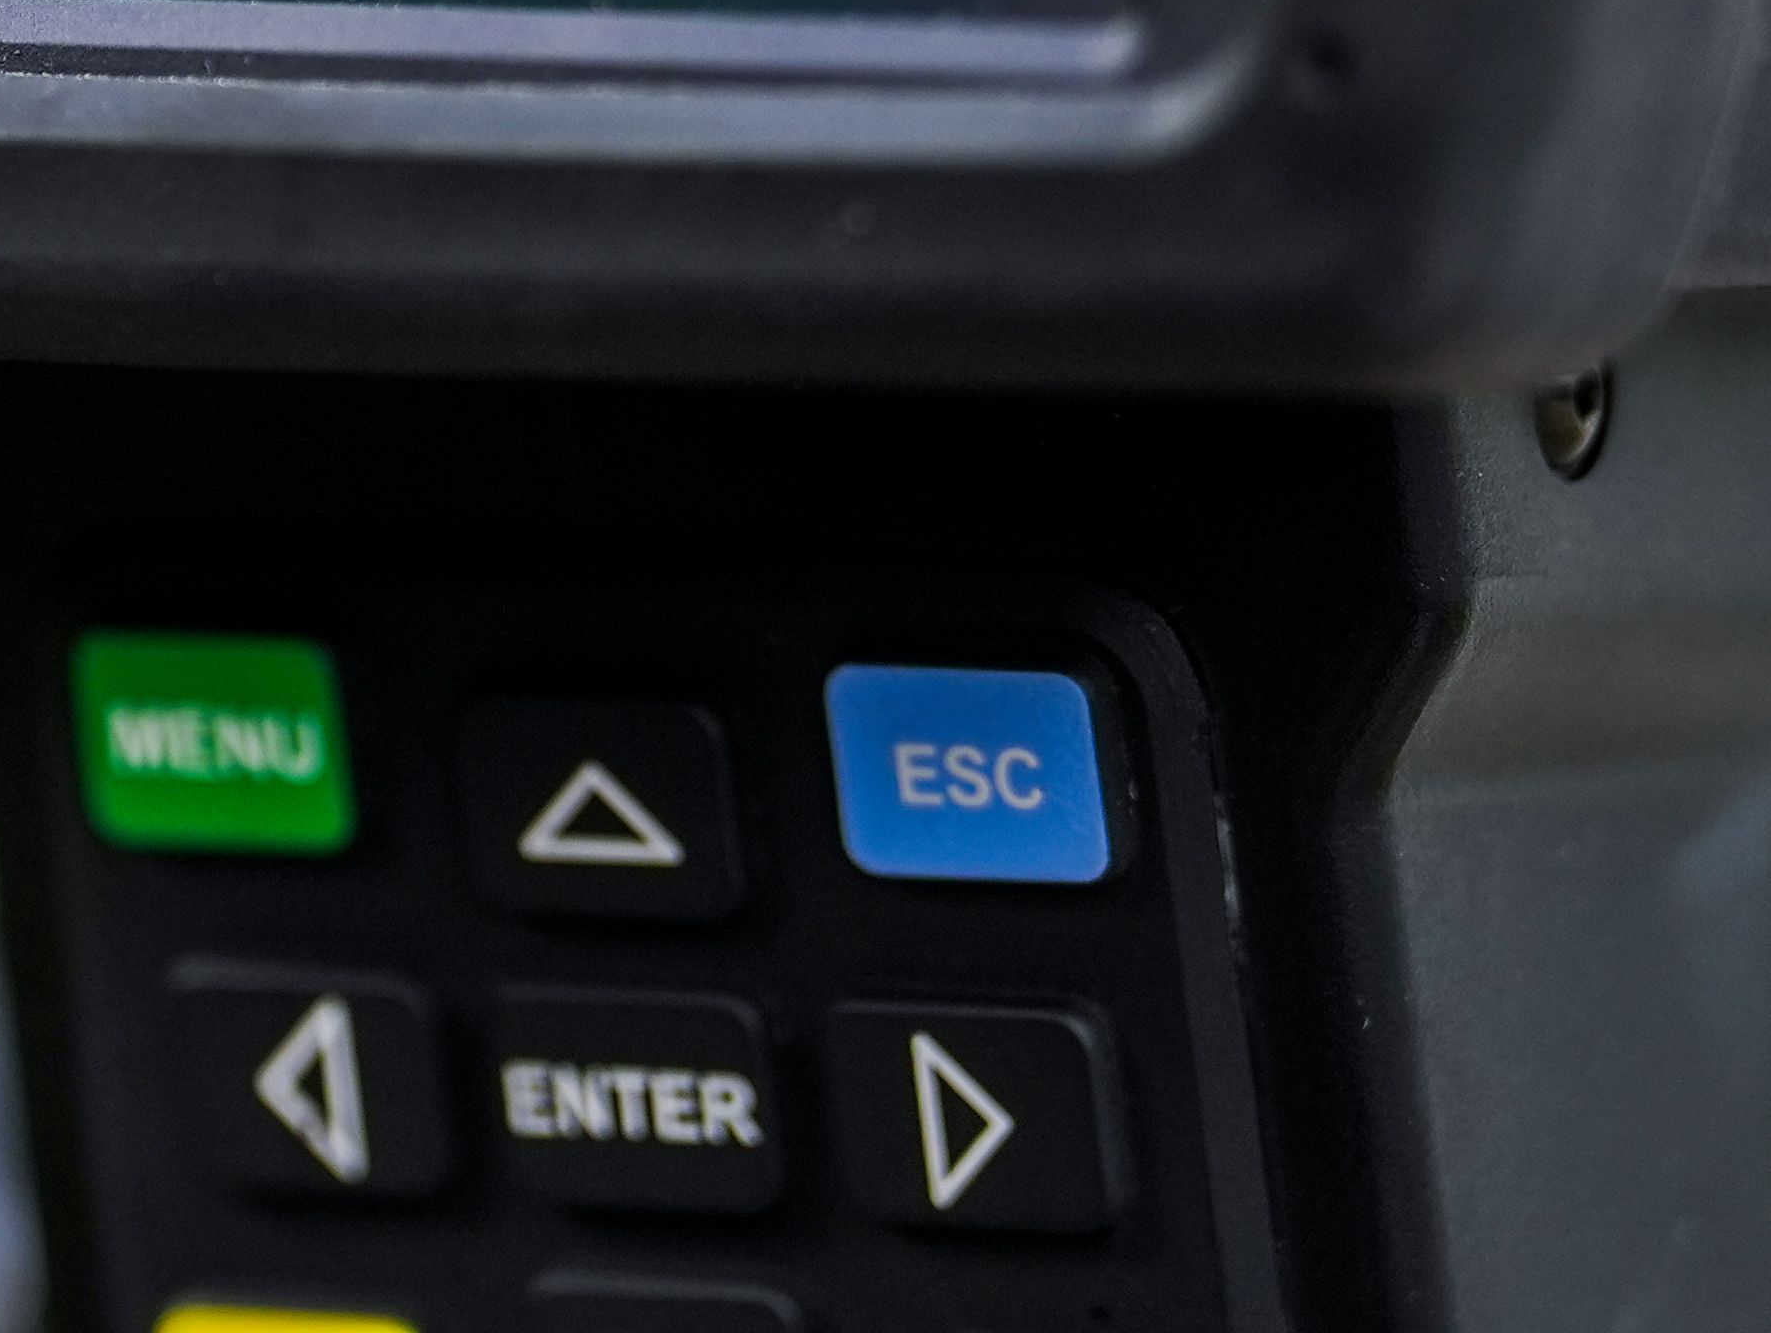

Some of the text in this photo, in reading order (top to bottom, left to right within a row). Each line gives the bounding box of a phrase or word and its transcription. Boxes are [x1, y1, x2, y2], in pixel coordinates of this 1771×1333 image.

[108, 699, 324, 783] MENU
[893, 741, 1044, 811] ESC
[501, 1058, 762, 1147] ENTER
